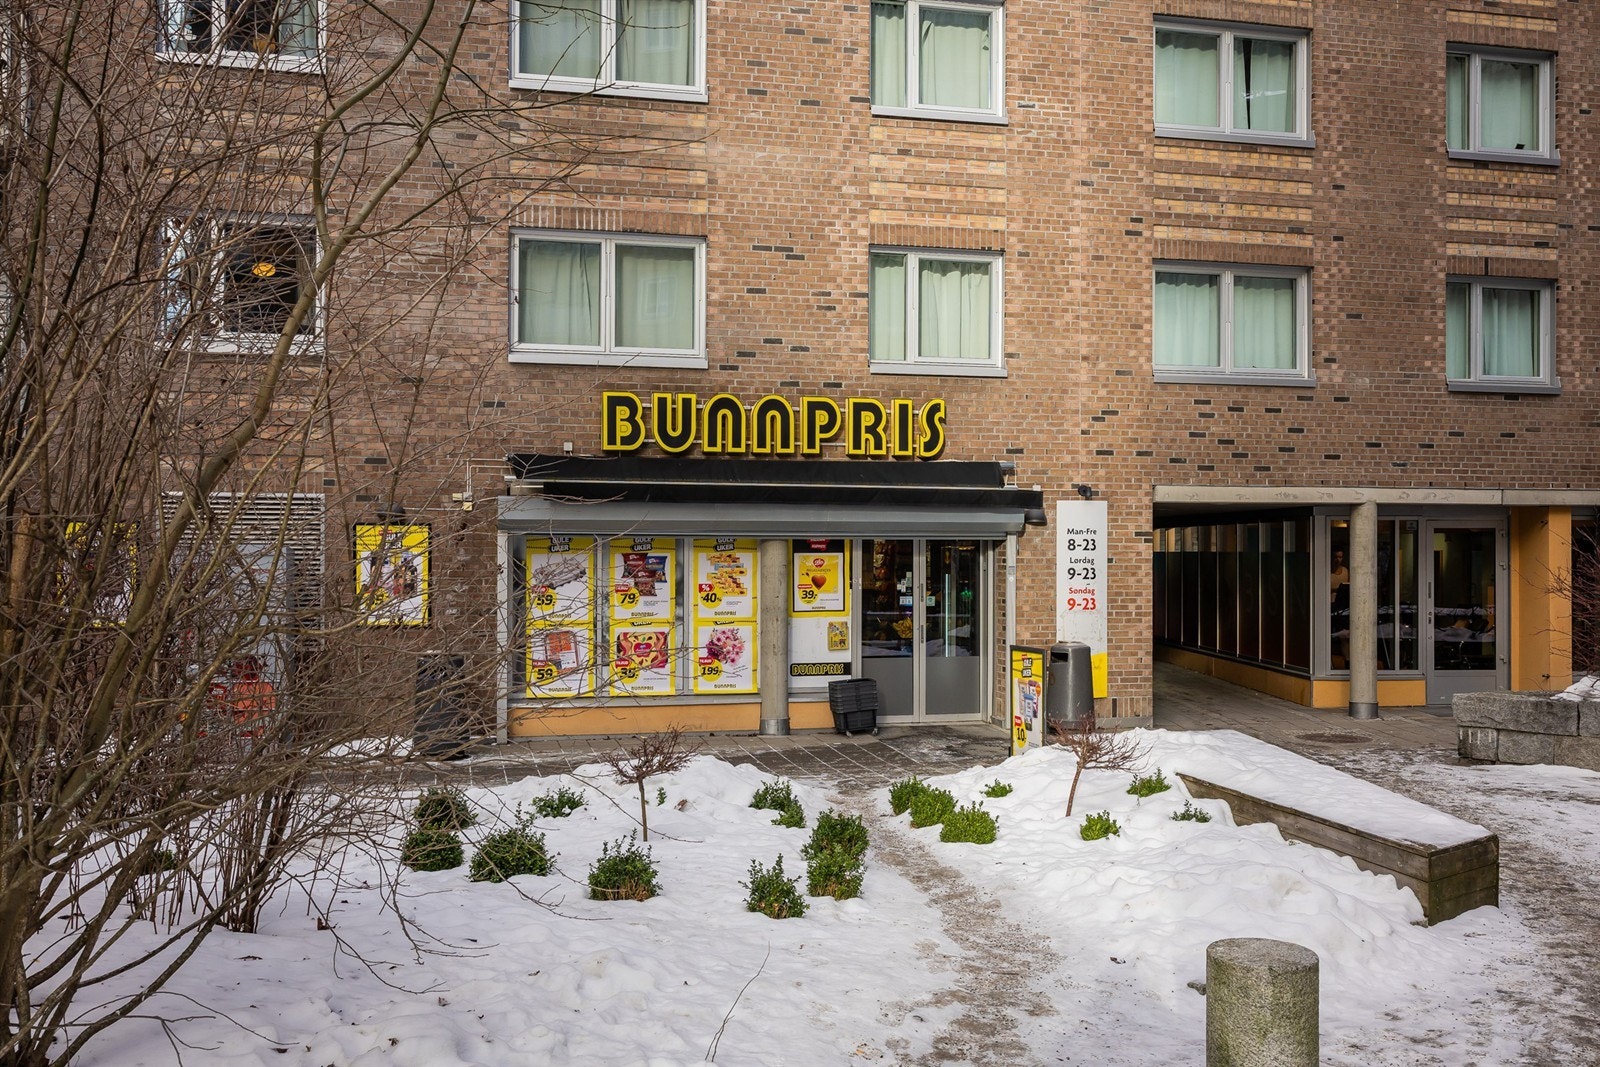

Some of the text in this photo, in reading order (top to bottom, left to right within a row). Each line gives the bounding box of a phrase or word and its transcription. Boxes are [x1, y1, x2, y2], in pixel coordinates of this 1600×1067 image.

[601, 391, 946, 458] BUNNPRIS
[1066, 527, 1098, 535] Man-Fre
[633, 543, 652, 551] UKER
[716, 543, 735, 551] UKER
[1067, 538, 1097, 551] 8-23
[1069, 556, 1095, 566] Lørdag
[1067, 567, 1097, 580] 9-23
[1068, 587, 1096, 596] Søndag
[1067, 598, 1097, 611] 9-23
[791, 664, 845, 675] BUNNPRIS
